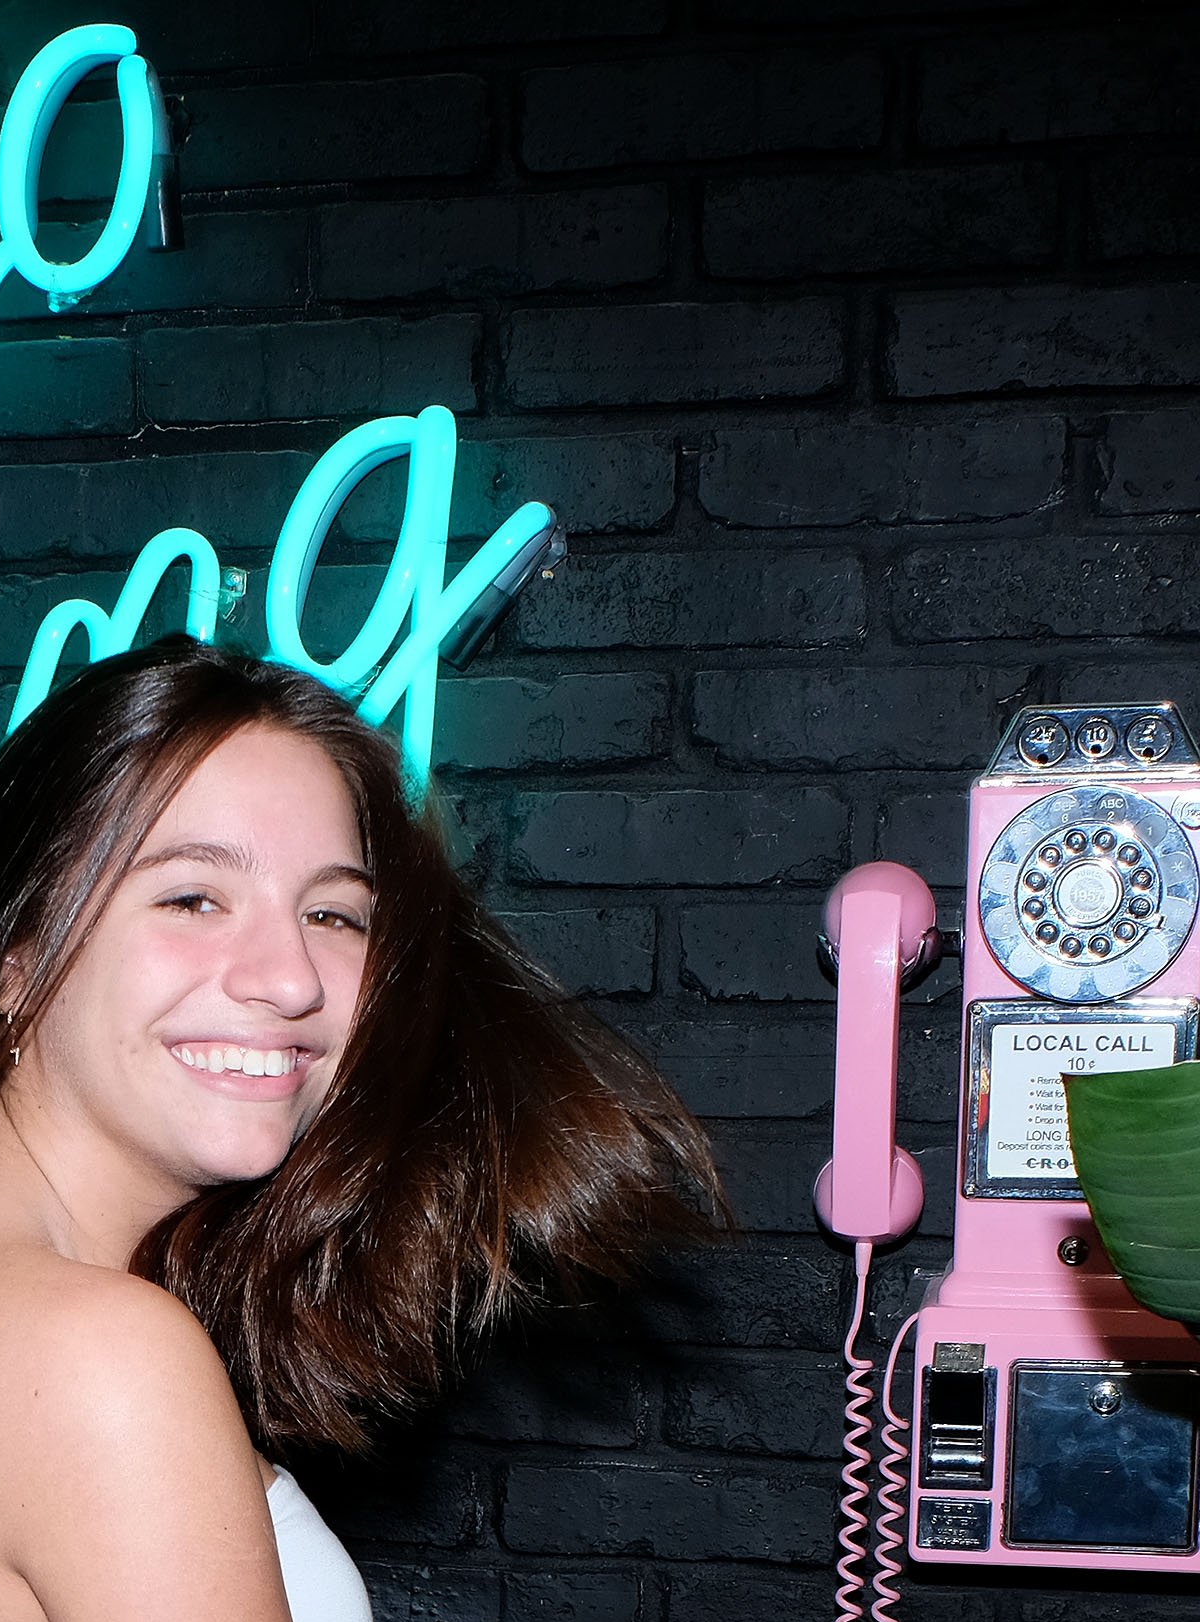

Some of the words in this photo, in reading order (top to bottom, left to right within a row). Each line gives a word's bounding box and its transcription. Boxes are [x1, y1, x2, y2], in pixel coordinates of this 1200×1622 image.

[1099, 798, 1124, 810] ABC
[1106, 811, 1115, 822] 2
[1071, 889, 1104, 903] 1957
[1013, 1034, 1088, 1051] LOCAL
[1096, 1035, 1153, 1052] CALL
[1035, 1116, 1055, 1125] Drop
[1026, 1130, 1062, 1142] LONG
[997, 1141, 1028, 1151] Deposit
[1030, 1142, 1053, 1150] coins
